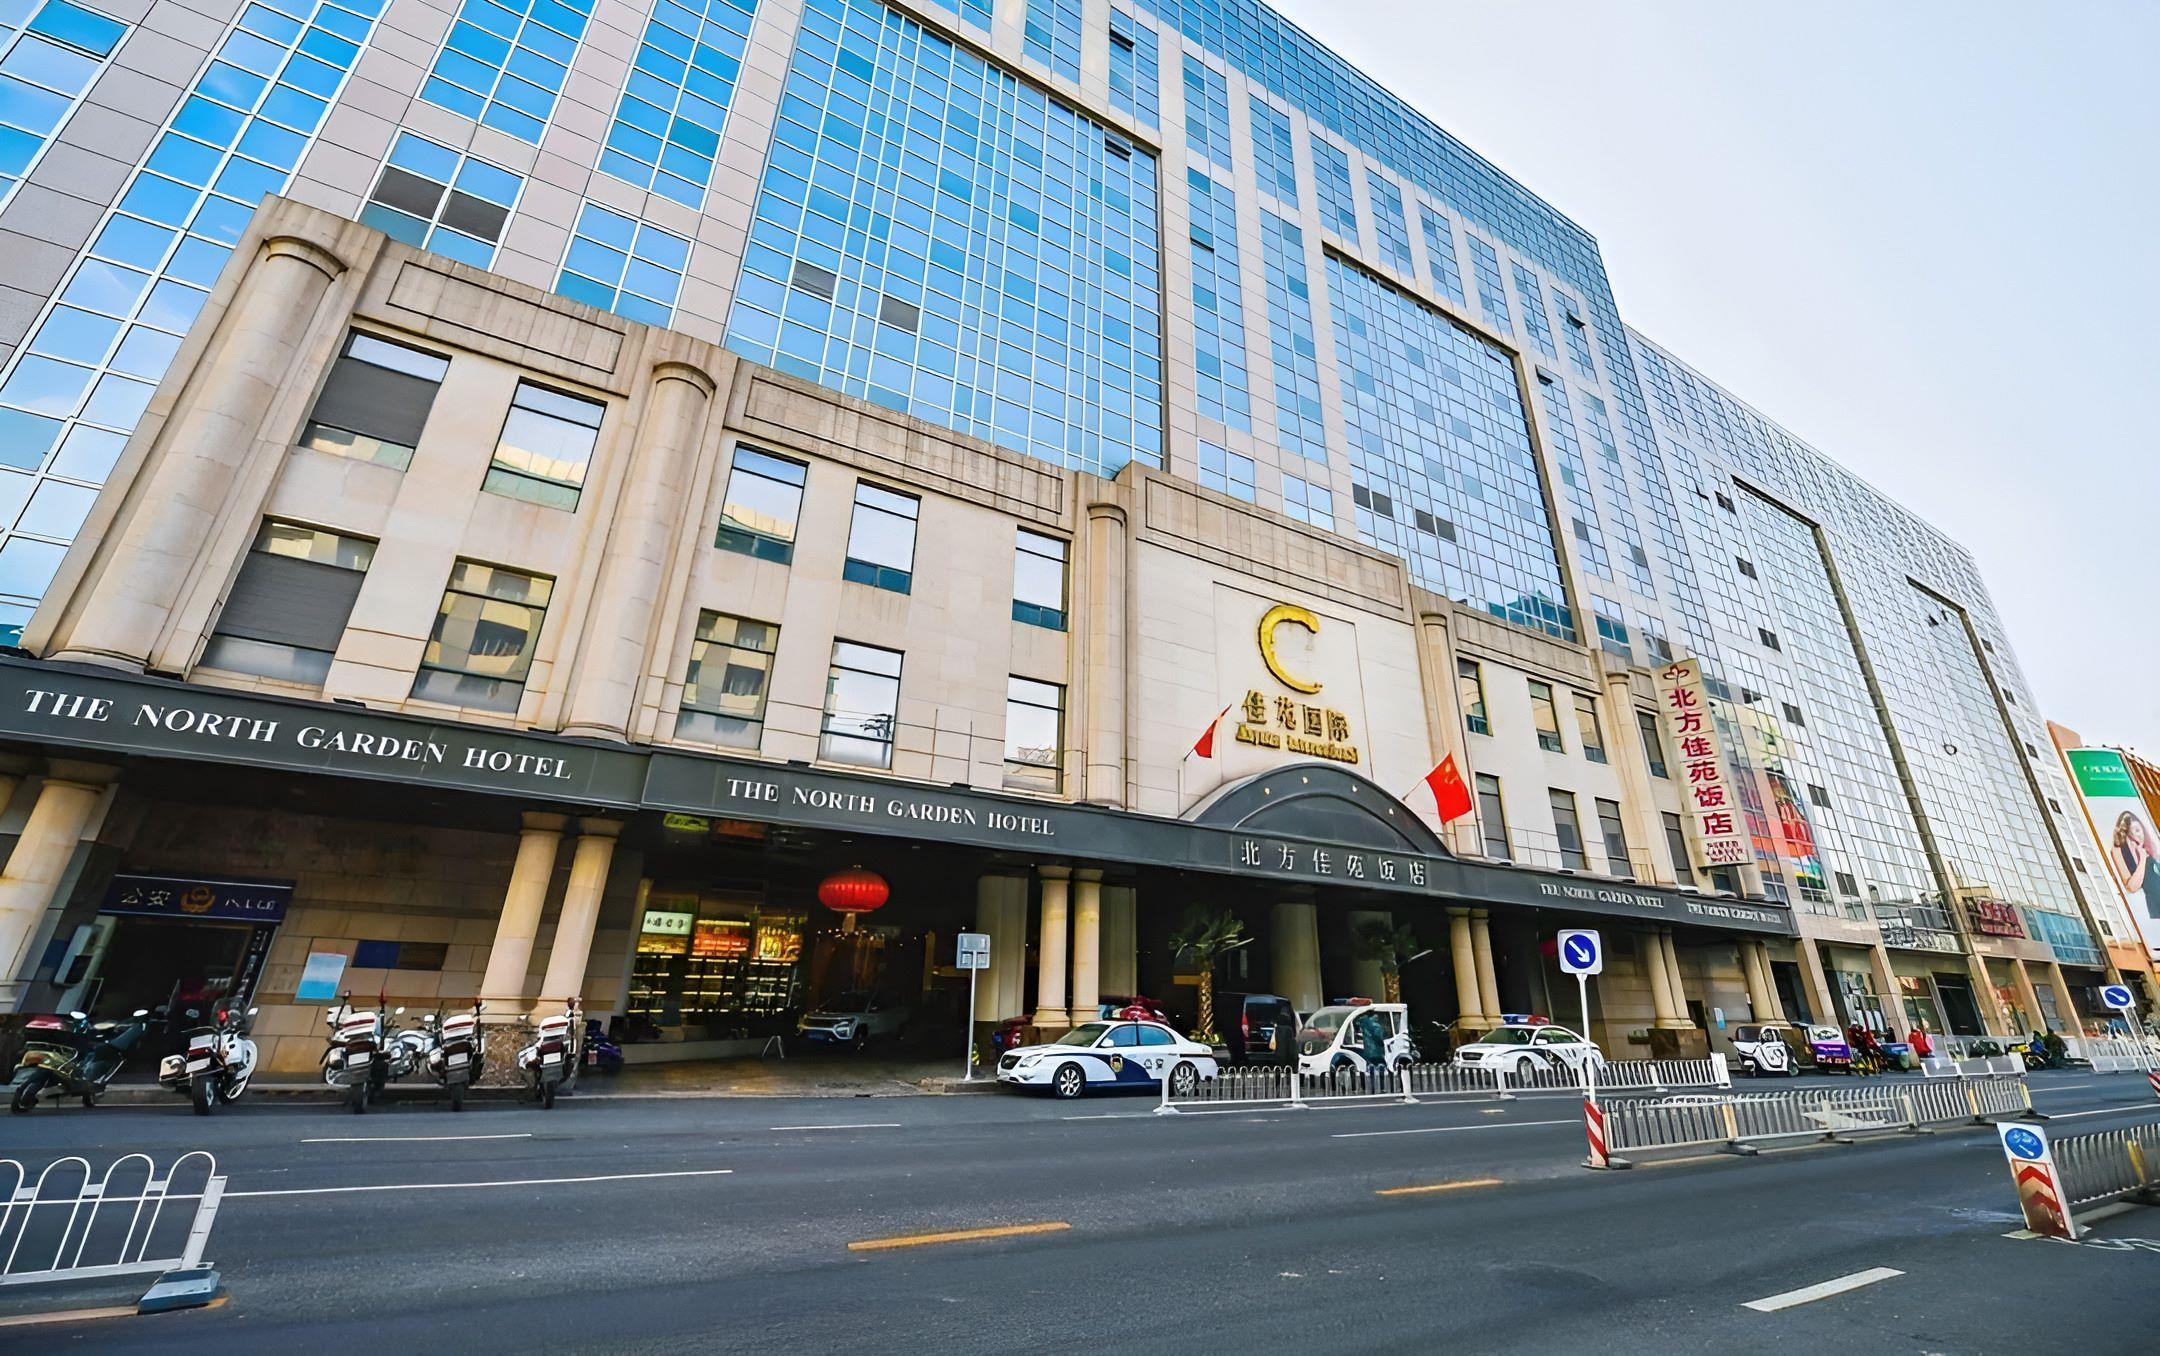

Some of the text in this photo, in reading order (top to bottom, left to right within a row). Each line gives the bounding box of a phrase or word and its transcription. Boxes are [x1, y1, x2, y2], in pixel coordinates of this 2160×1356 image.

[24, 689, 573, 780] THE NORTH GARDEN HOTEL
[1668, 688, 1734, 836] 北方佳苑饭店
[727, 778, 1056, 836] THE NORTH GARDEN HOTEL
